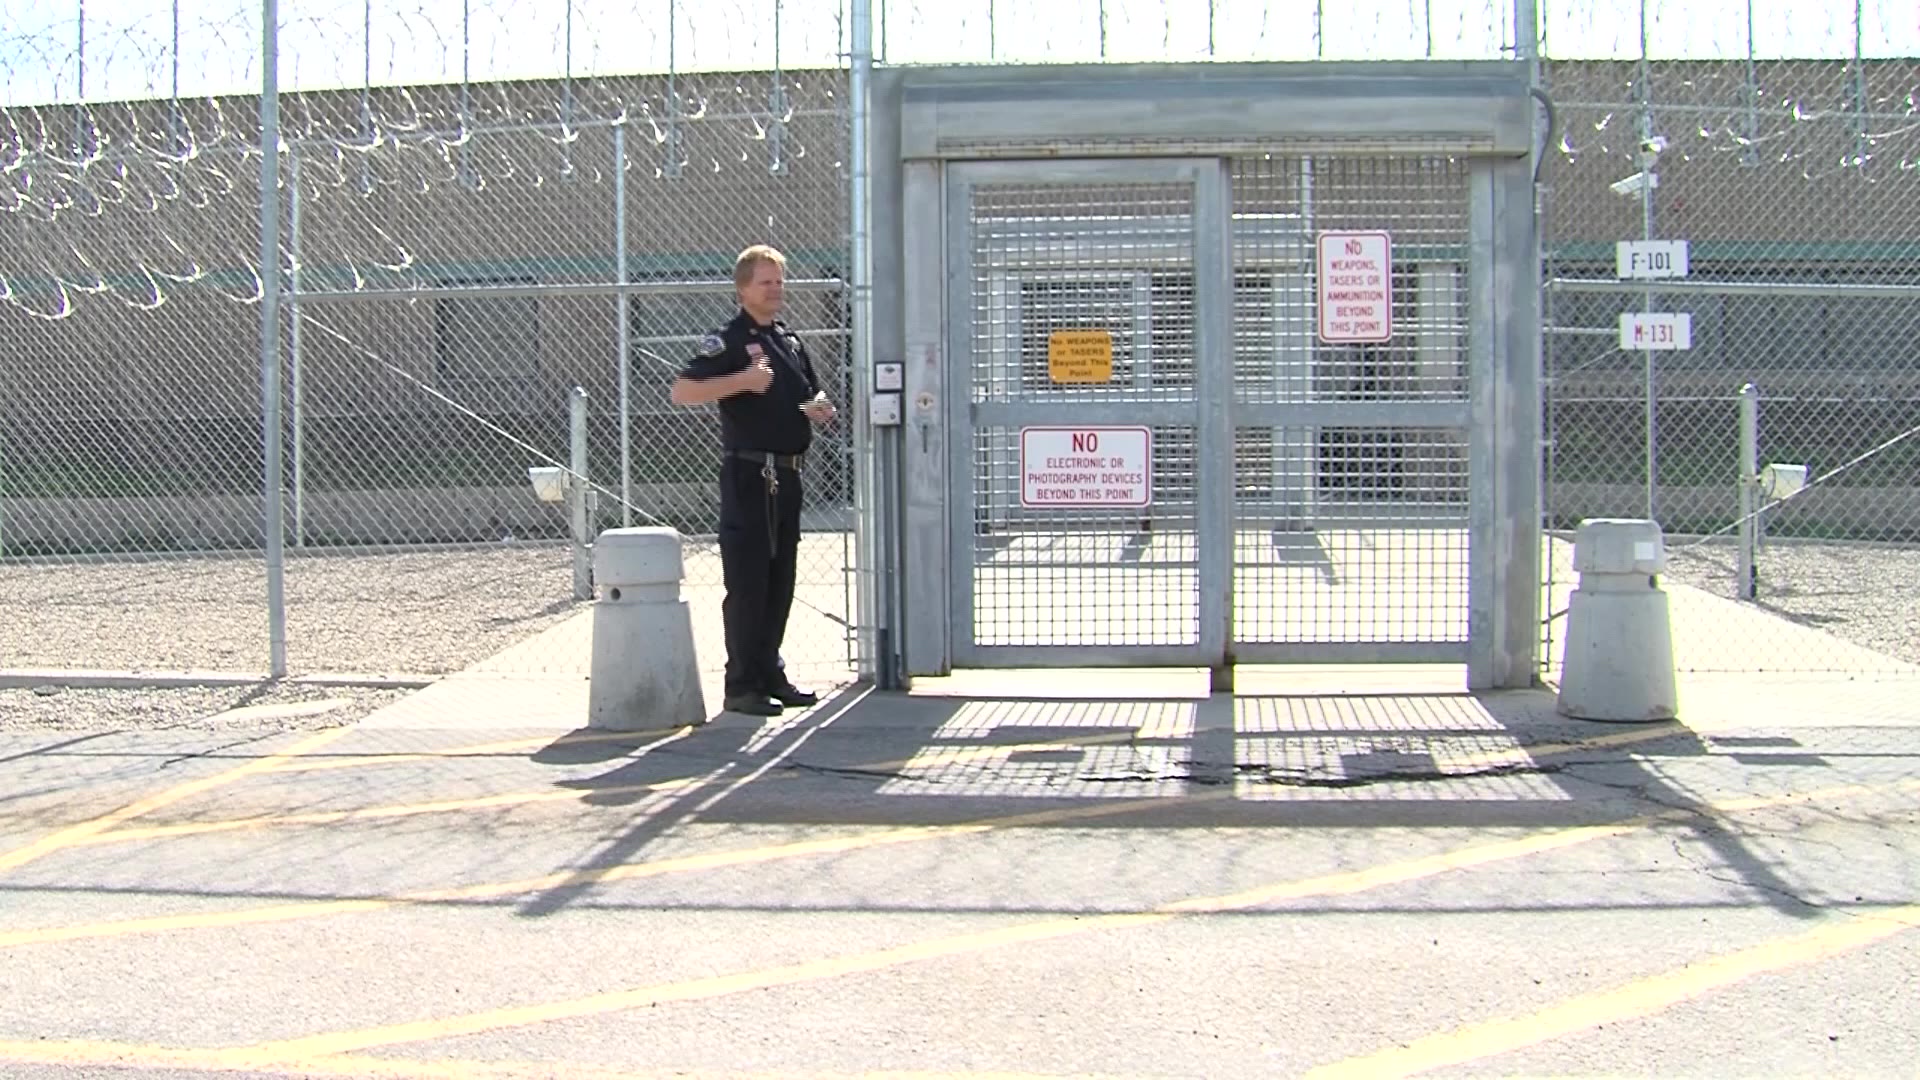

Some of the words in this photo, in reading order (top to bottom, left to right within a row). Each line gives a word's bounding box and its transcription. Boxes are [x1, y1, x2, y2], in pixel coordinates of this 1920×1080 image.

[1345, 240, 1362, 255] NO
[1631, 252, 1671, 270] F-101
[1329, 276, 1364, 286] TASERS
[1367, 276, 1380, 286] OR
[1327, 291, 1384, 301] AMMUNITION
[1336, 306, 1374, 317] BEYOND
[1330, 322, 1350, 332] THIS
[1353, 321, 1381, 332] POINT
[1634, 324, 1674, 343] M-131
[1072, 433, 1098, 453] NO
[1046, 457, 1106, 469] ELECTRONIC
[1110, 457, 1125, 469] OR
[1028, 473, 1097, 485] PHOTOGRAPHY
[1101, 473, 1143, 485] DEVICES
[1036, 488, 1076, 500] BEYOND
[1079, 488, 1102, 500] THIS
[1105, 488, 1134, 500] POINT
